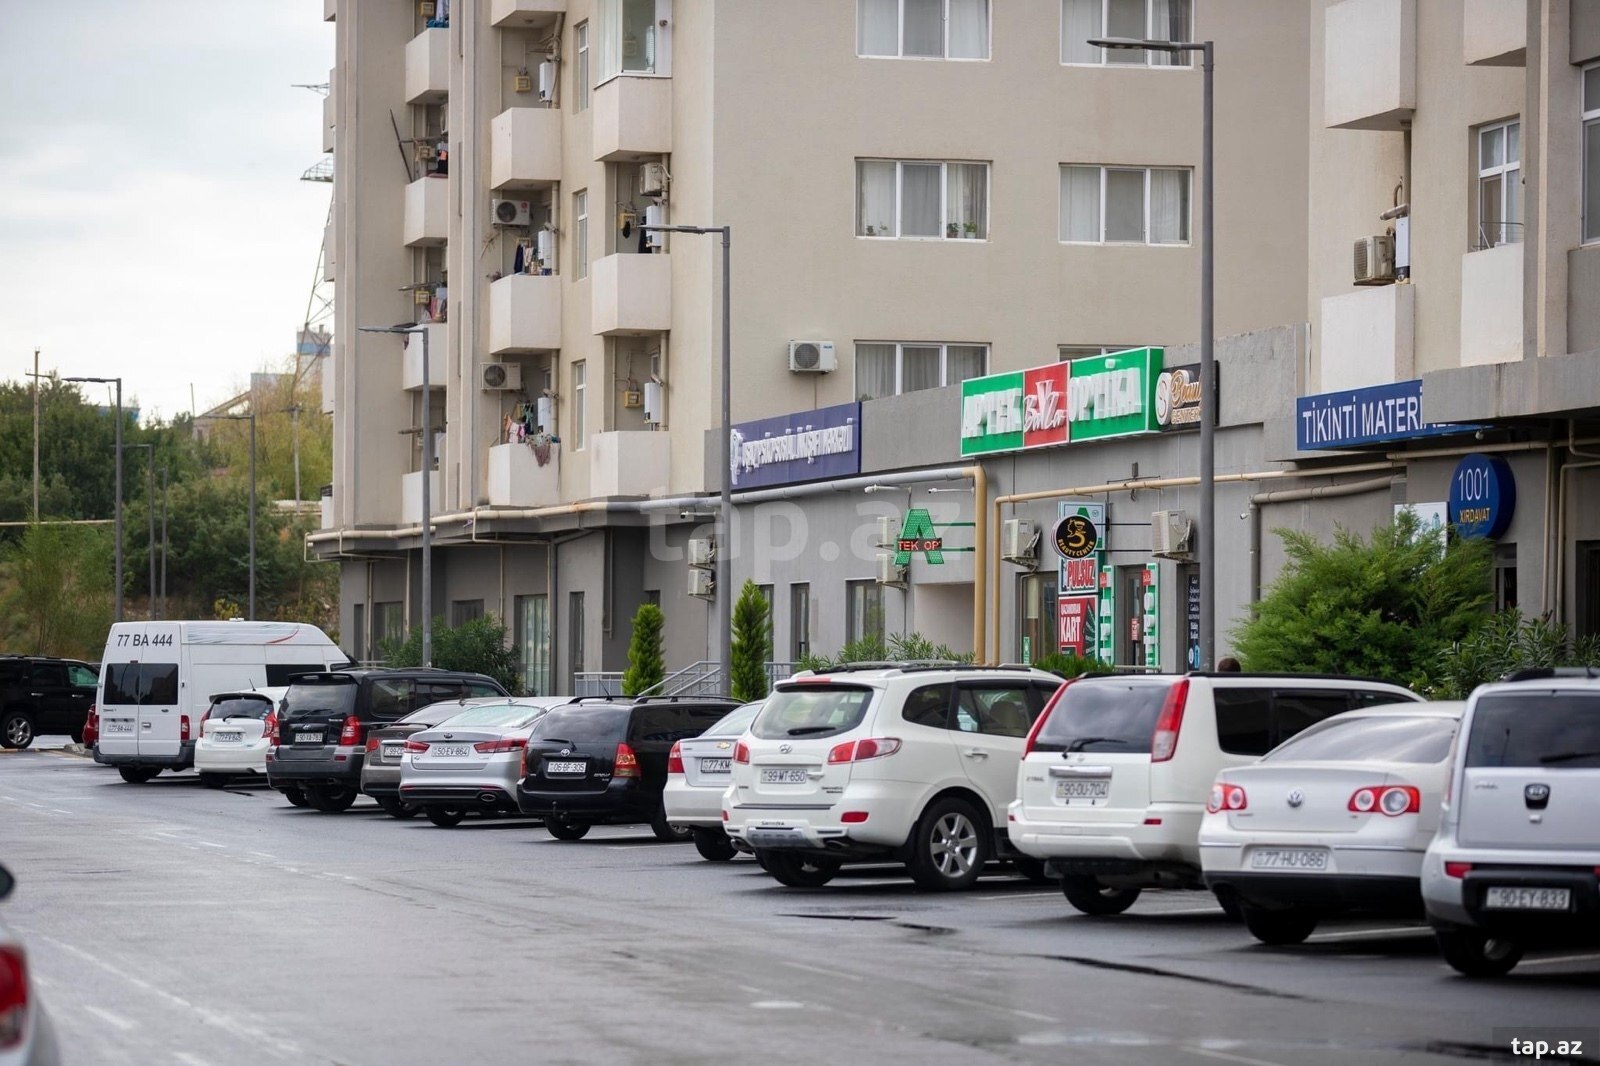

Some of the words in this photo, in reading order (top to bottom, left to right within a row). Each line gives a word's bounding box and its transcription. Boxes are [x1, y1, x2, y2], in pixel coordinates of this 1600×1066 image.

[962, 387, 1022, 438] APTEK
[1303, 396, 1357, 443] TİKİNTİ
[1458, 467, 1489, 502] 1001
[1459, 507, 1491, 523] XIRDAVAT
[923, 540, 942, 551] OP
[1058, 538, 1076, 557] BEAUTY
[1066, 559, 1096, 588] PULSUZ
[117, 634, 129, 646] 77
[133, 634, 149, 646] BA
[152, 634, 173, 646] 444
[1061, 616, 1081, 642] KART
